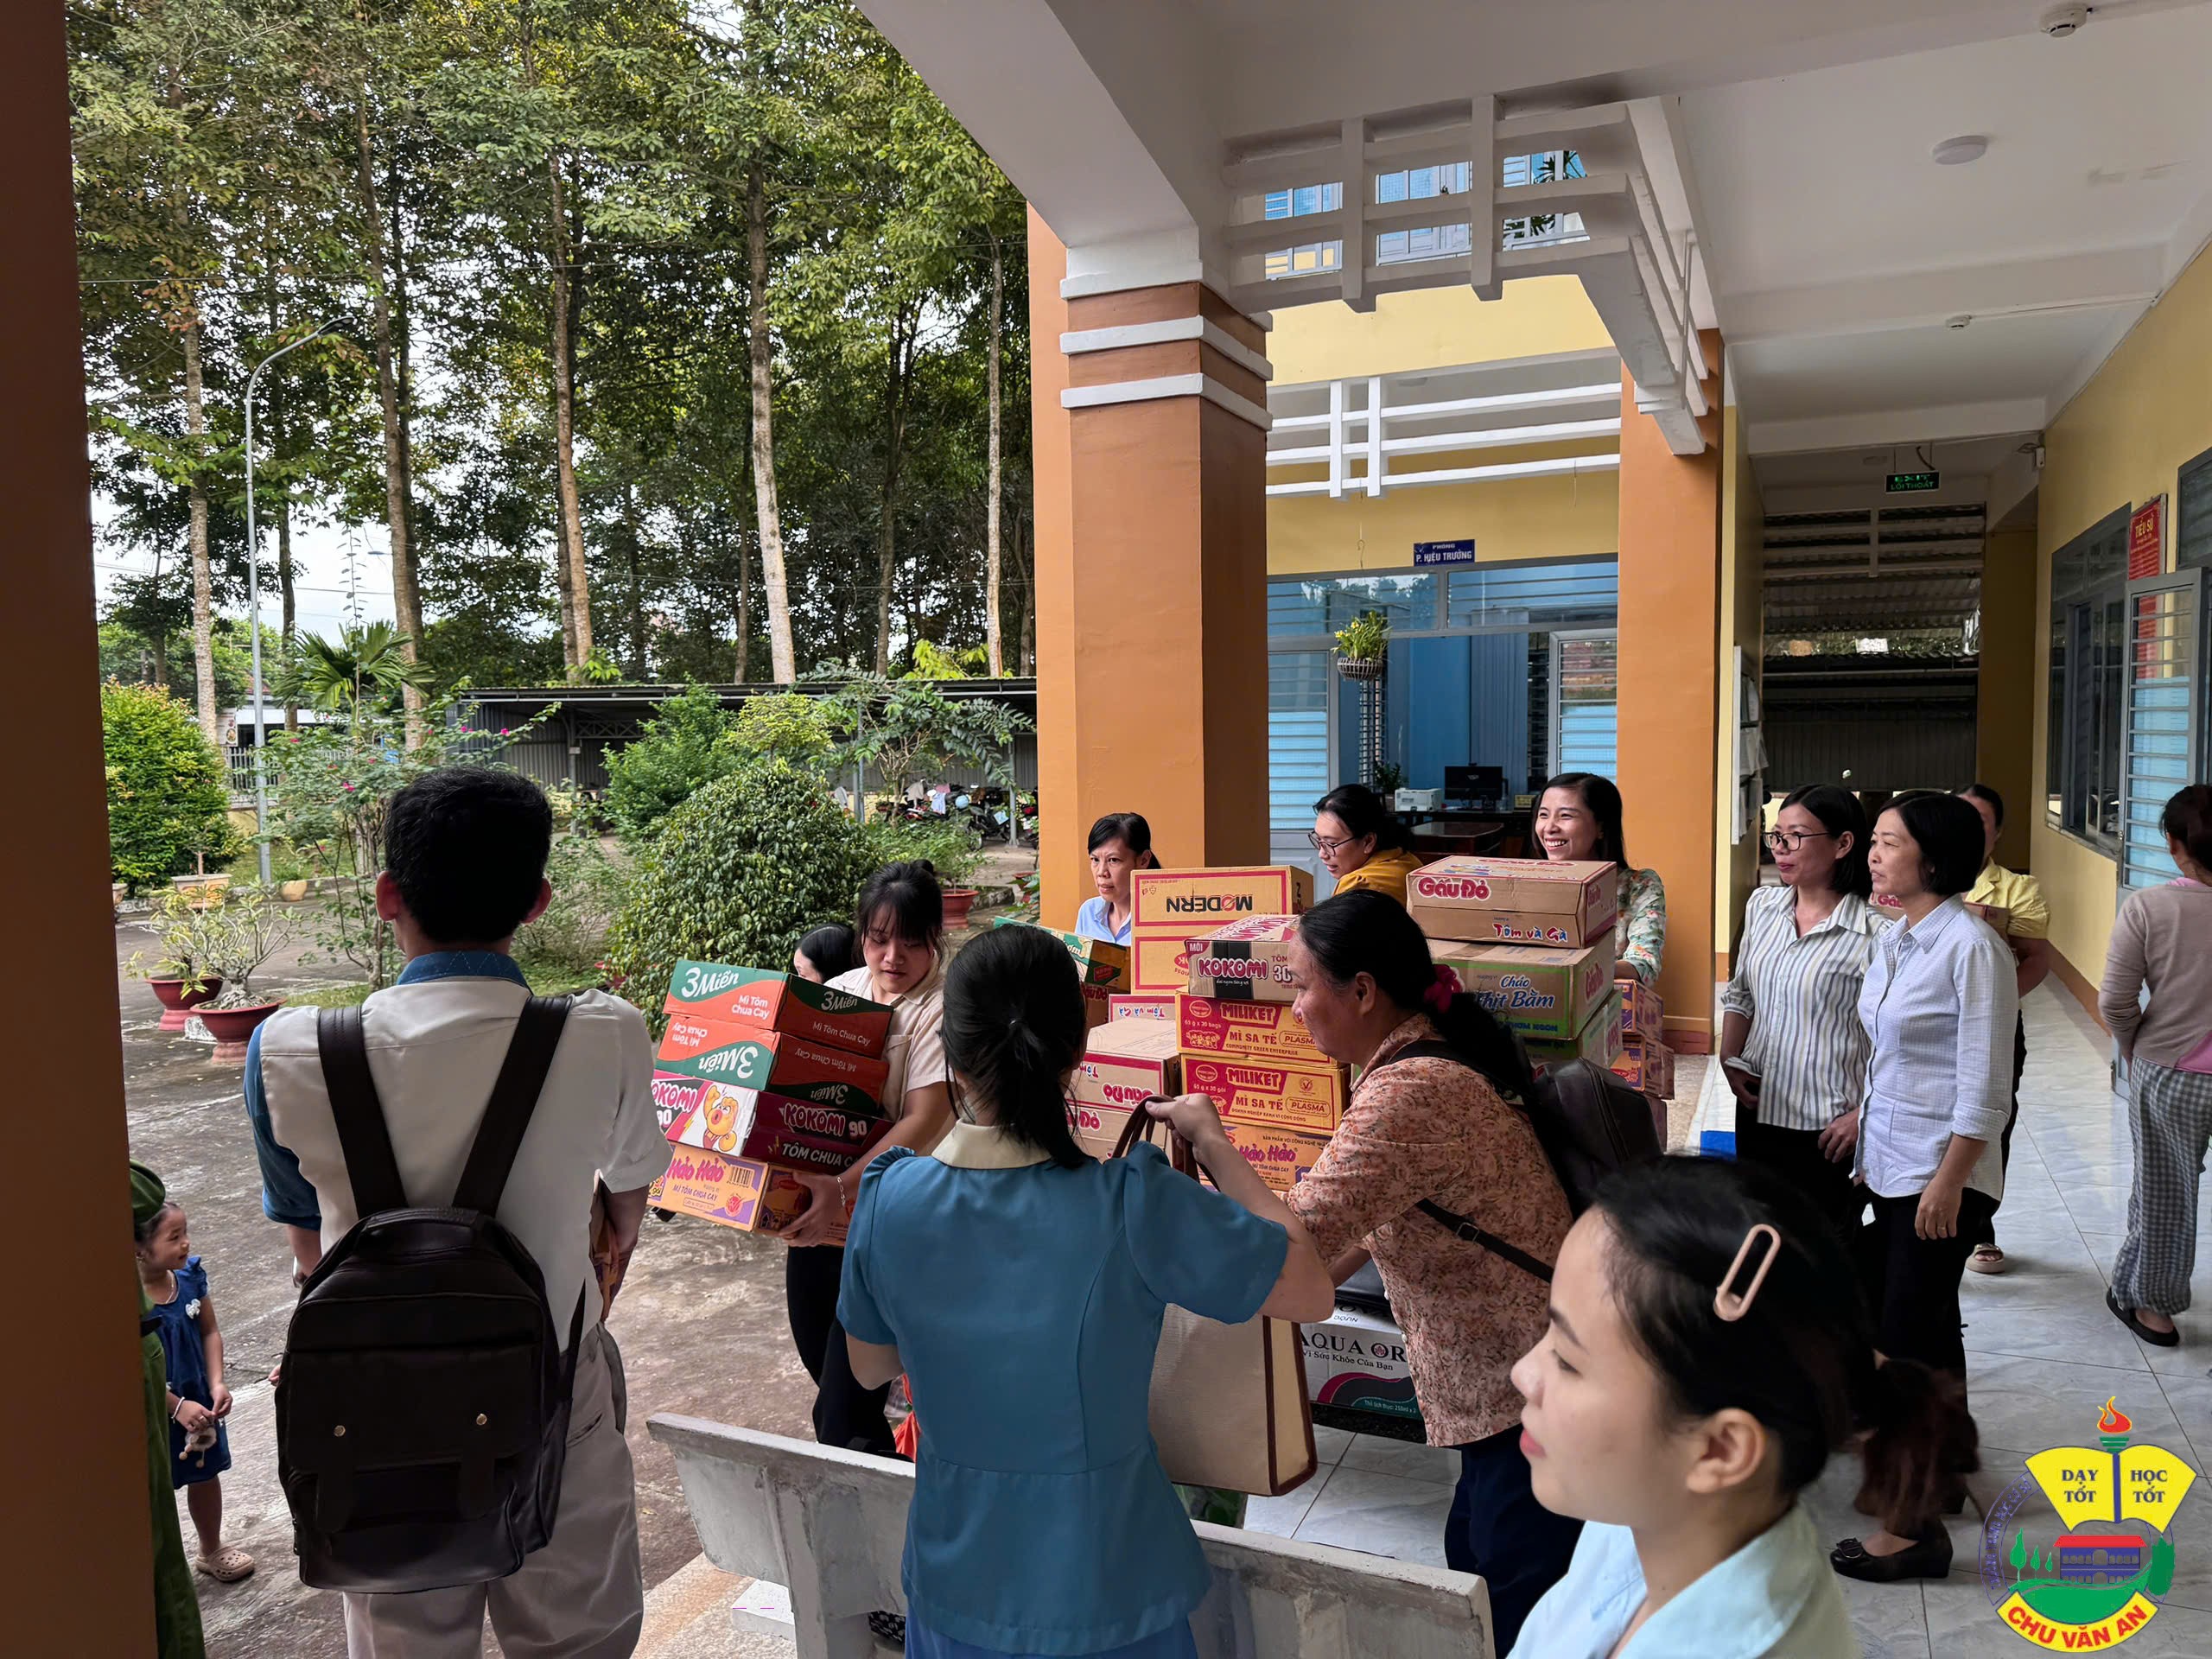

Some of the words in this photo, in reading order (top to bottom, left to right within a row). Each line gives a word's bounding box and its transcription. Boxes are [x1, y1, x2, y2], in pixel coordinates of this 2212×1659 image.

[1415, 554, 1422, 563] P.
[1166, 895, 1252, 912] MODERN
[1197, 957, 1269, 980] KOKOMI
[1500, 975, 1530, 988] Cháo
[751, 996, 768, 1007] Tôm
[732, 1004, 753, 1016] Chua
[753, 1007, 771, 1020] Cay
[1221, 1002, 1276, 1022] MILIKET
[672, 1022, 686, 1033] Cay
[687, 1026, 708, 1038] Chua
[857, 1035, 871, 1046] Cay
[1245, 1033, 1259, 1043] SA
[1285, 1036, 1315, 1045] PLASM
[1227, 1067, 1281, 1090] MILIKET
[652, 1082, 697, 1113] OKOMI
[1251, 1099, 1265, 1109] SA
[1291, 1102, 1325, 1112] PLASMA
[784, 1103, 846, 1136] KOKOMI
[849, 1120, 868, 1138] 90
[782, 1141, 809, 1160] TÔM
[810, 1150, 842, 1166] CHUA
[1268, 1143, 1296, 1162] Hảo
[667, 1156, 695, 1181] Hảo
[695, 1158, 724, 1183] Hảo
[707, 1192, 717, 1201] CAY
